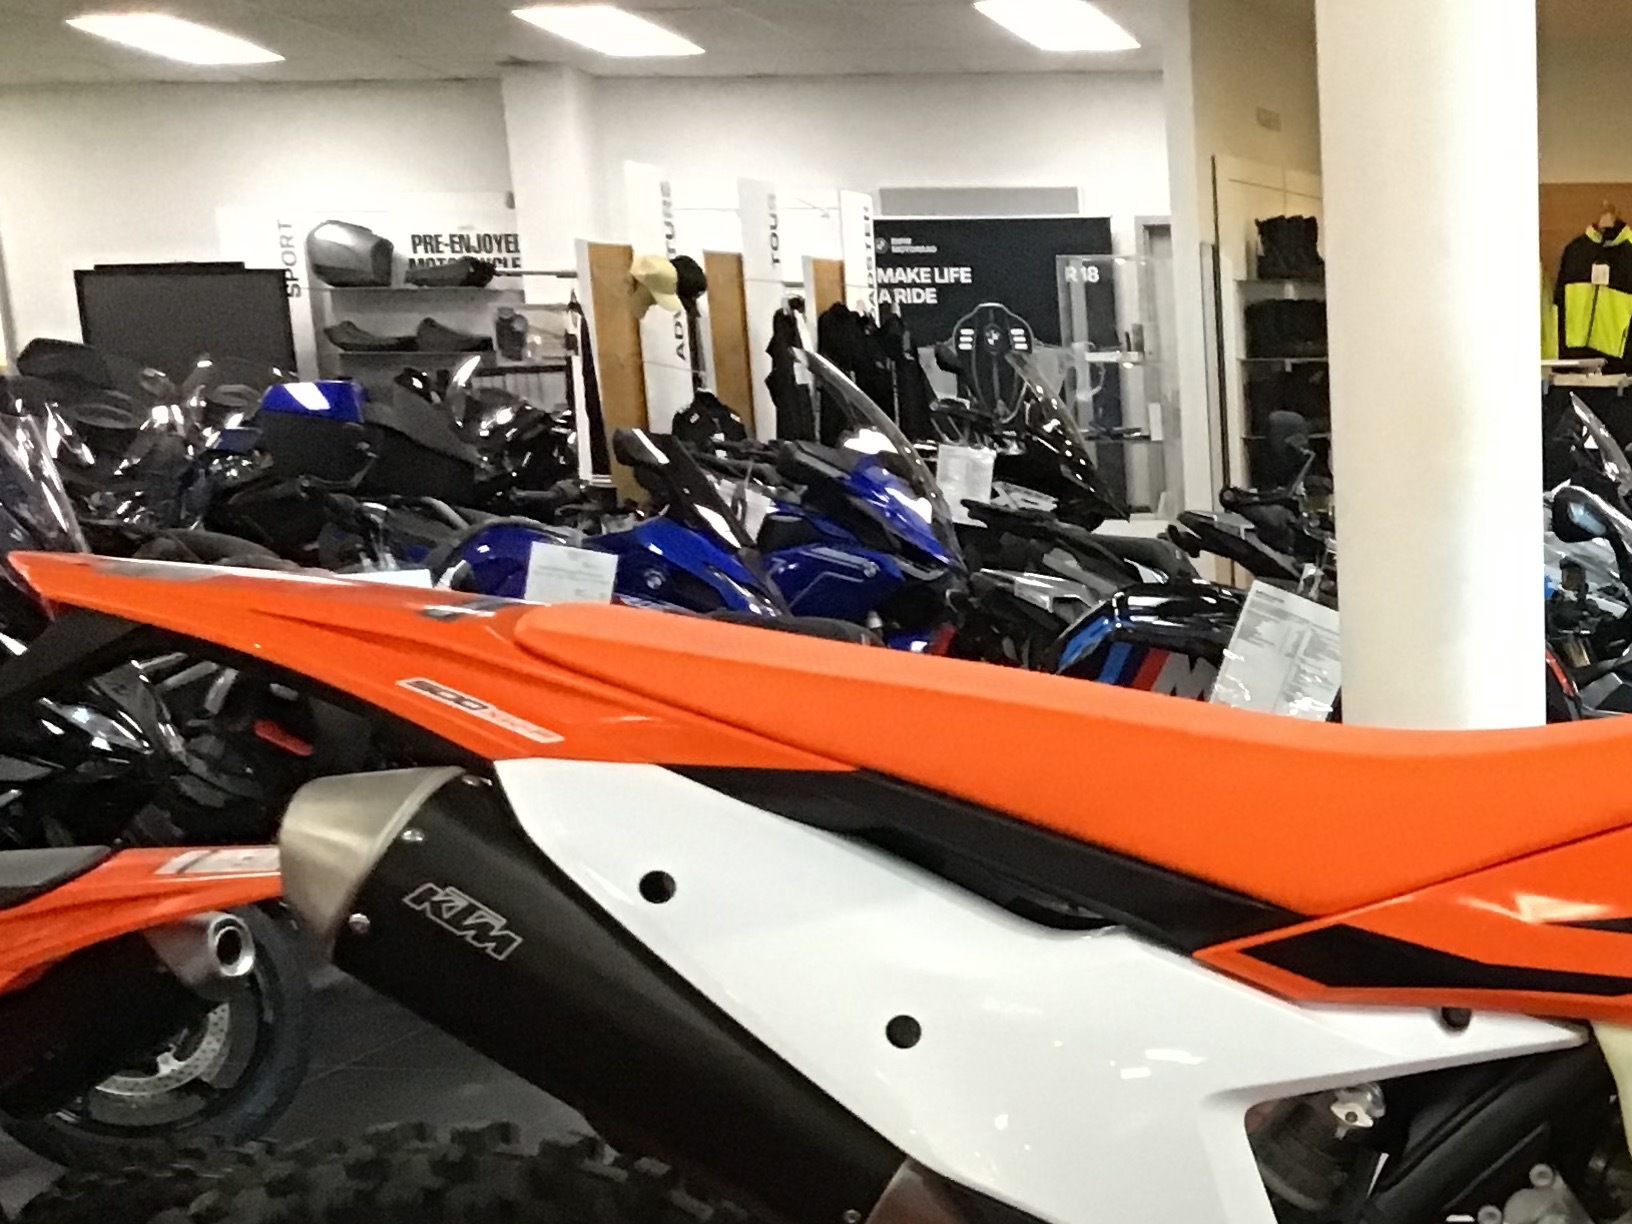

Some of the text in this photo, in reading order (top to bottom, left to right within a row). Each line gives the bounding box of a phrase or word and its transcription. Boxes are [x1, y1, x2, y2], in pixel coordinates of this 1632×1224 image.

[277, 221, 301, 298] SPORT
[876, 266, 973, 285] MAKE LIFE
[1064, 266, 1100, 283] R 18
[877, 287, 939, 304] A RIDE
[402, 883, 523, 960] KTM
